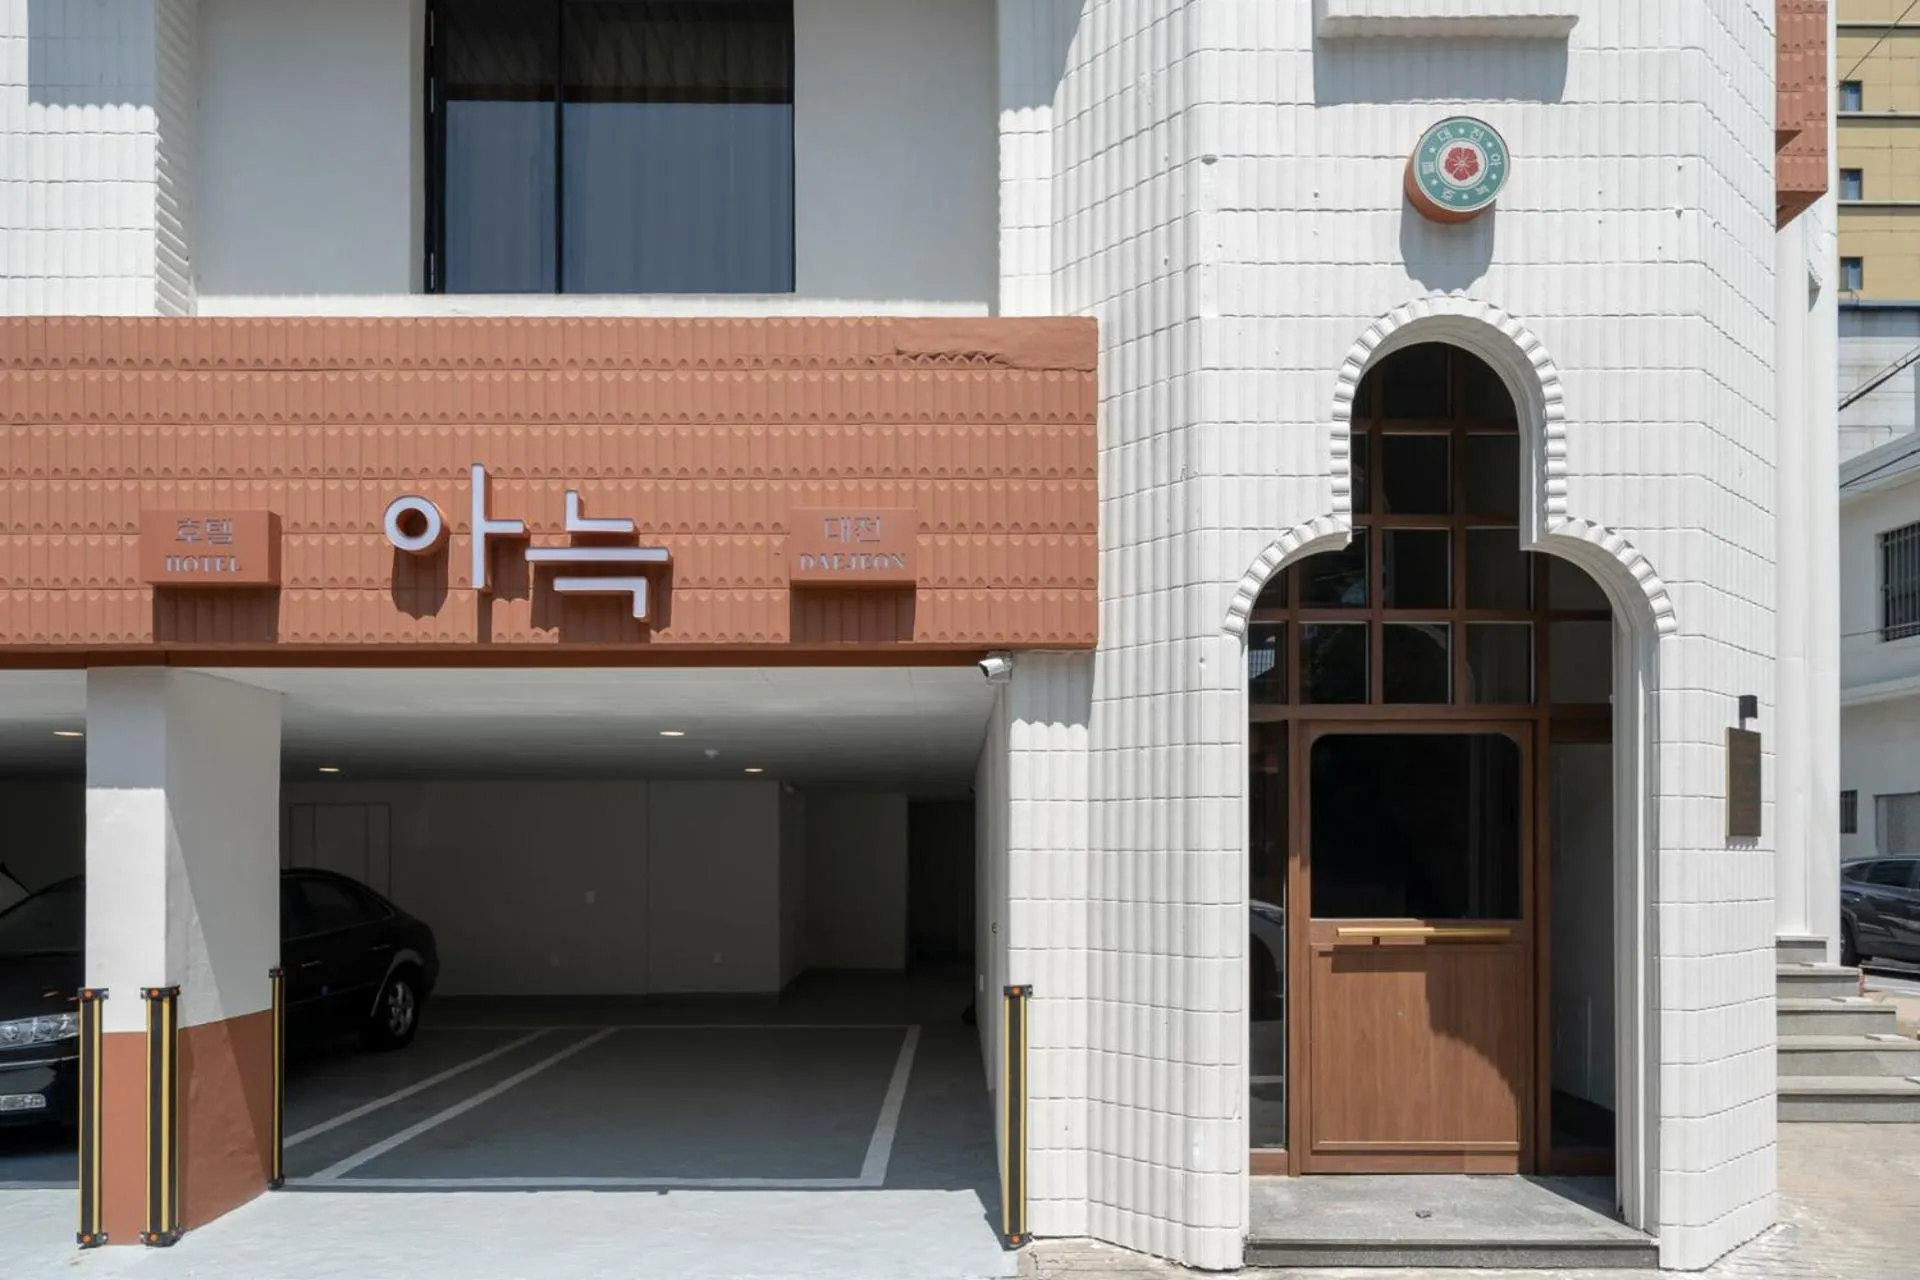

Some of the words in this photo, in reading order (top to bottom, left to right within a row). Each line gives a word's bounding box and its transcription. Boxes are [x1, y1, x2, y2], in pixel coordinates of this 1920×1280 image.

[174, 517, 234, 545] 호텔
[384, 463, 670, 618] 아늑
[824, 516, 881, 543] 대전
[165, 554, 242, 572] HOTEL
[799, 552, 906, 571] DAEJEON
